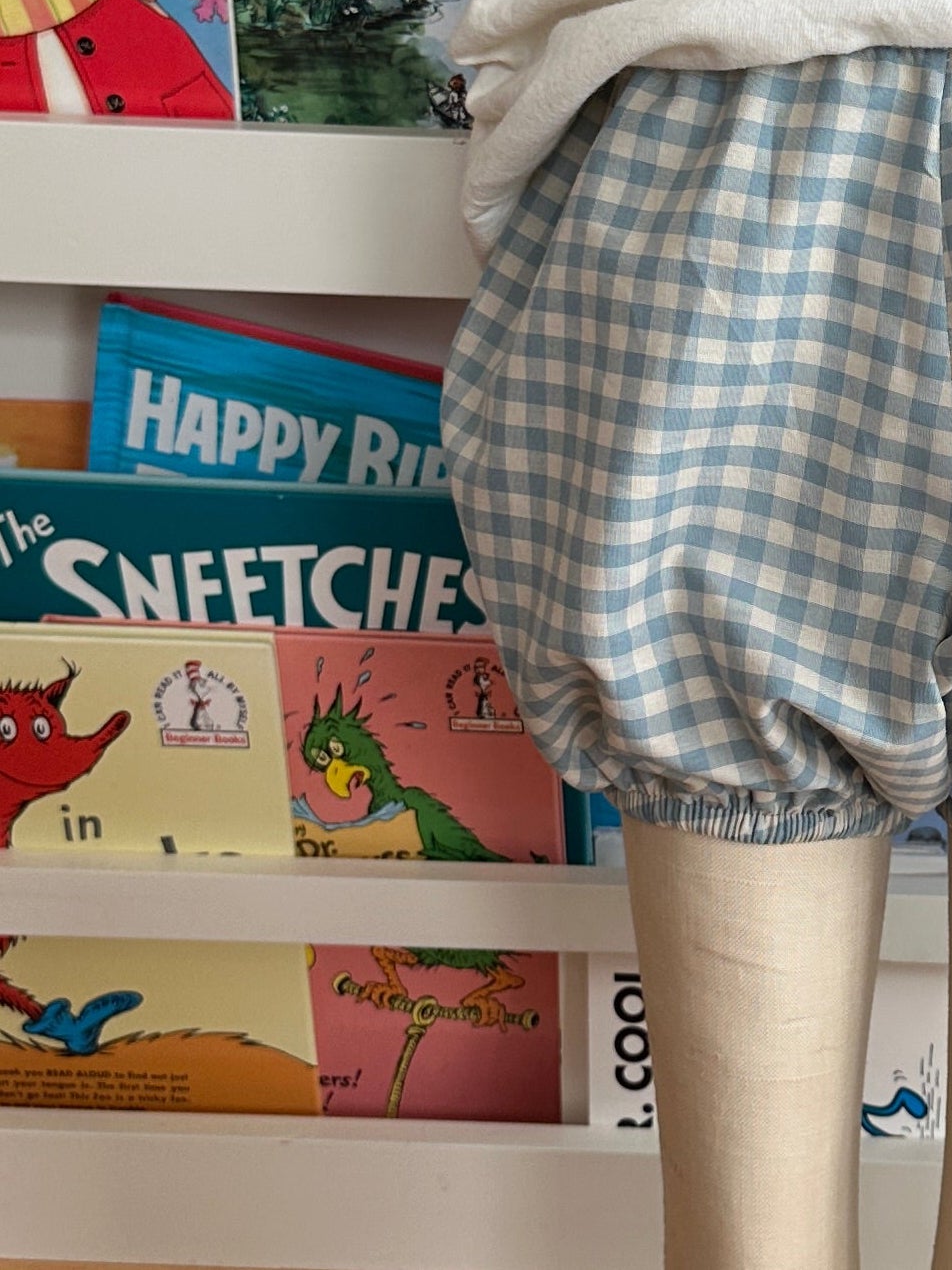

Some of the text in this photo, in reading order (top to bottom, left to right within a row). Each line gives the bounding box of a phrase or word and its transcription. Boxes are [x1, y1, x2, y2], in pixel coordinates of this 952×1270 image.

[126, 368, 342, 483] HAPPY
[0, 510, 55, 568] The
[60, 804, 102, 842] in
